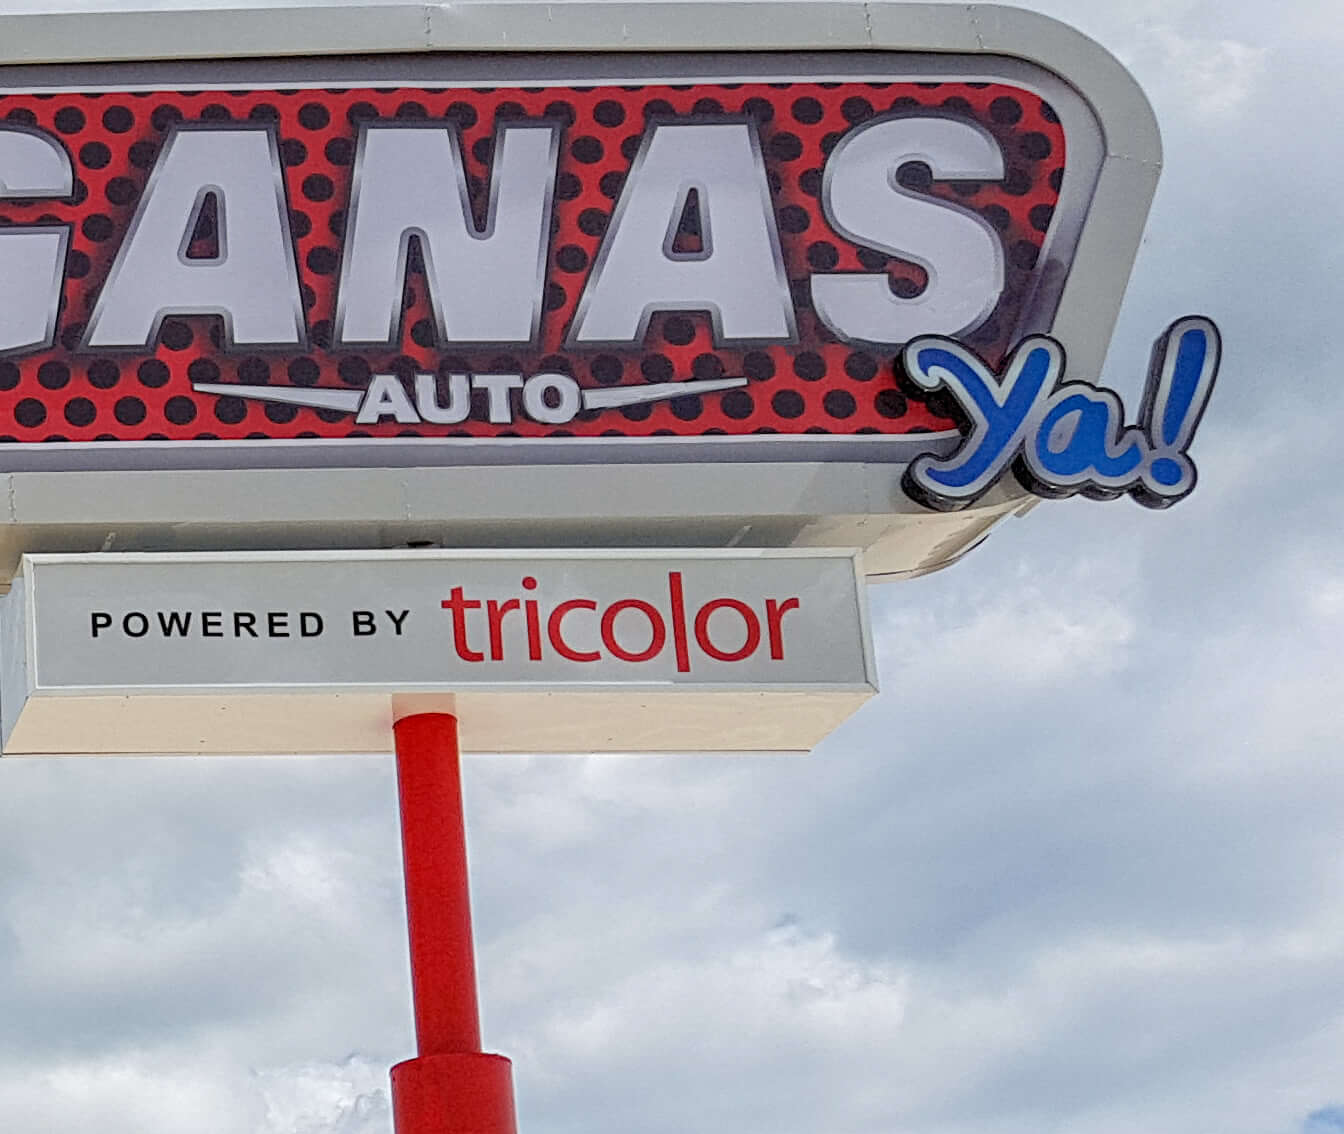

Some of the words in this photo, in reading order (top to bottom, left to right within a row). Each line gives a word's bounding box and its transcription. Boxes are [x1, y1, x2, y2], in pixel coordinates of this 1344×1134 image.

[355, 371, 583, 426] AUTO
[902, 314, 1223, 500] Ya!
[90, 610, 325, 639] POWERED
[352, 609, 411, 637] BY
[441, 573, 800, 672] tricolor
